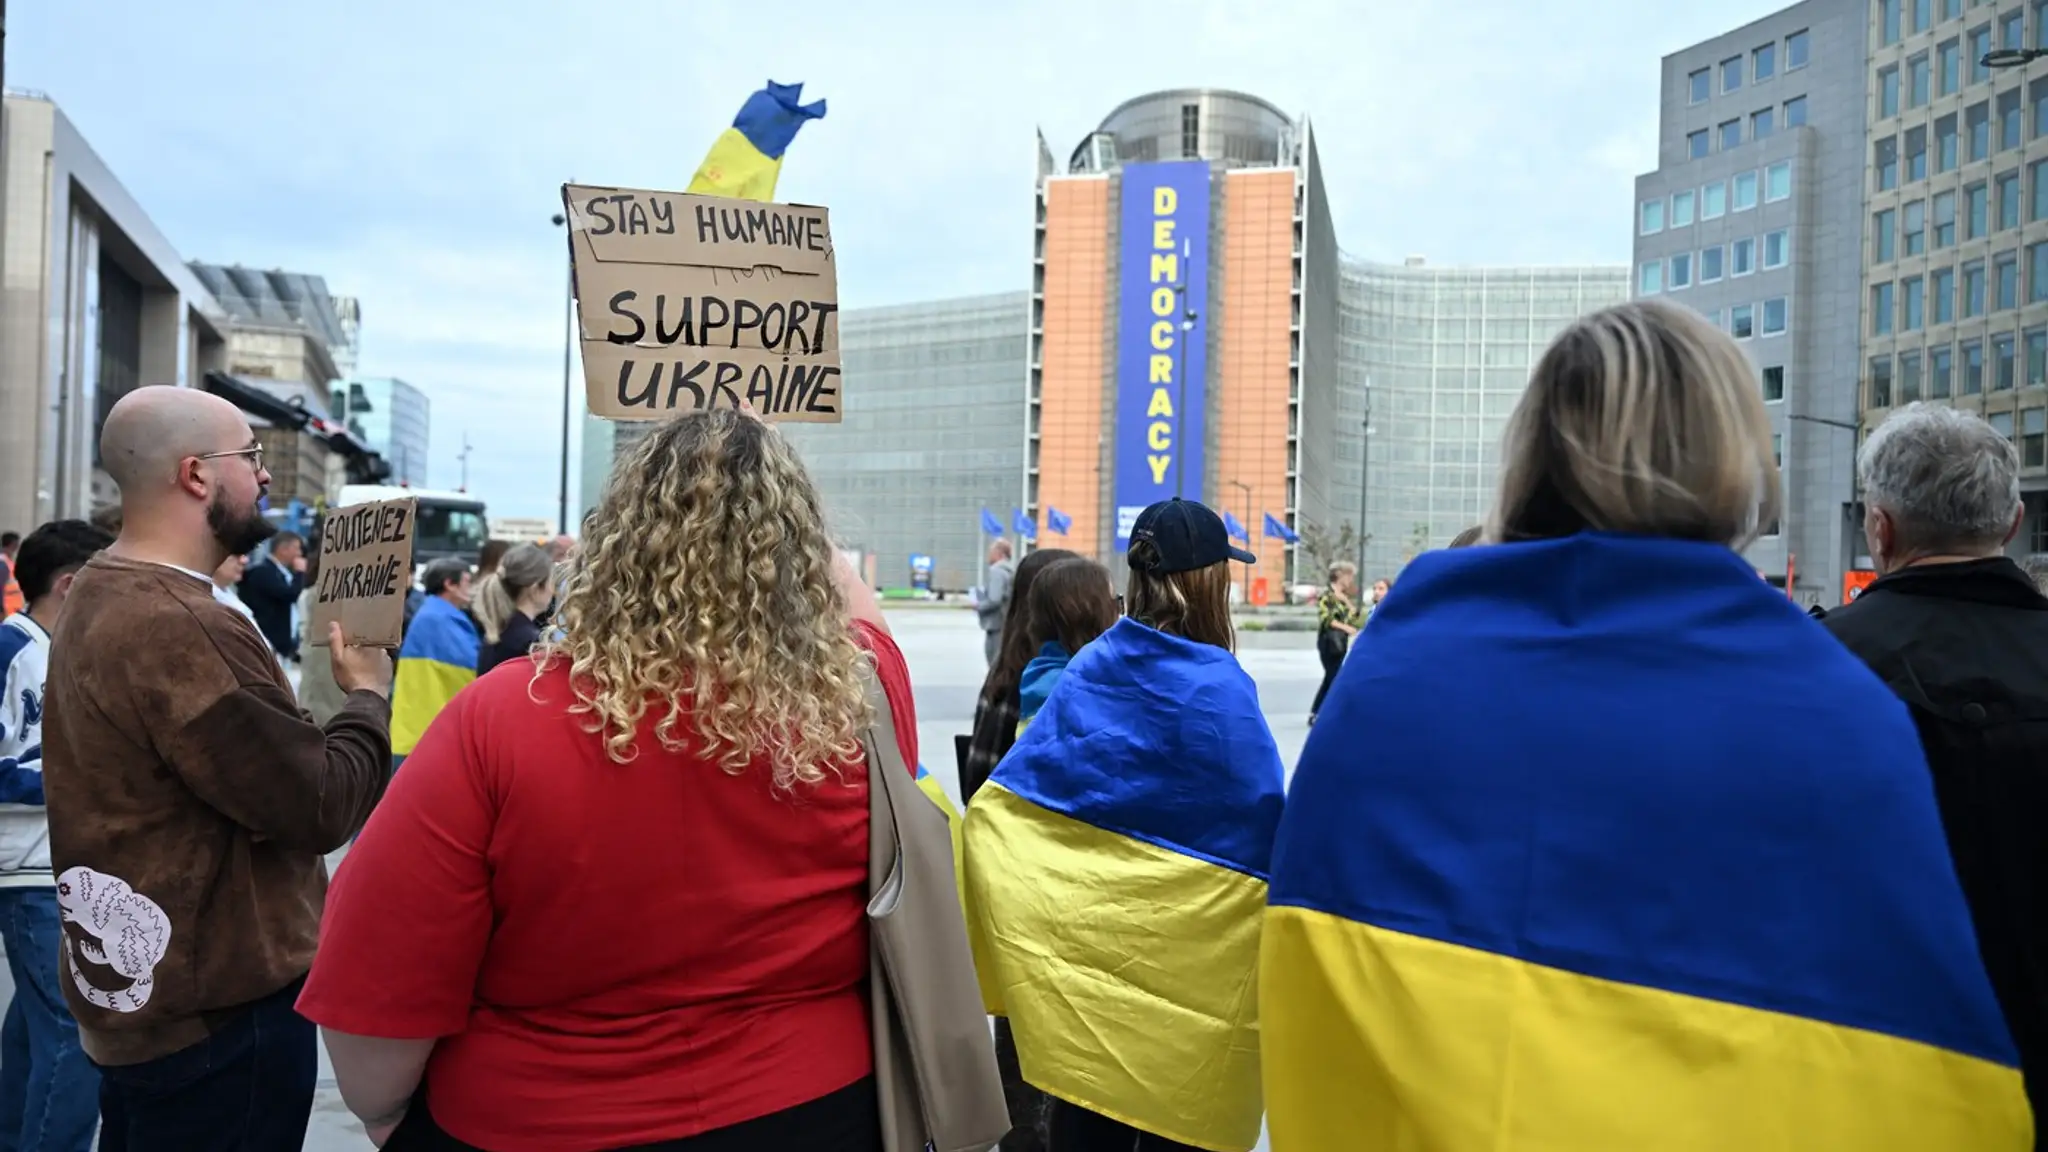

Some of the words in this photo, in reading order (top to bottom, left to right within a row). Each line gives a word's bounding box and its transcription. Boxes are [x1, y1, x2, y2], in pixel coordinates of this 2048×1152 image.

[586, 195, 675, 235] STAY
[695, 204, 824, 251] HUMANE
[607, 290, 838, 355] SUPPORT
[1147, 187, 1177, 484] DEMOCRACY
[617, 357, 841, 414] UKRAINE
[324, 506, 407, 554] SOUTENEZ
[318, 554, 402, 603] L'UKRAINE
